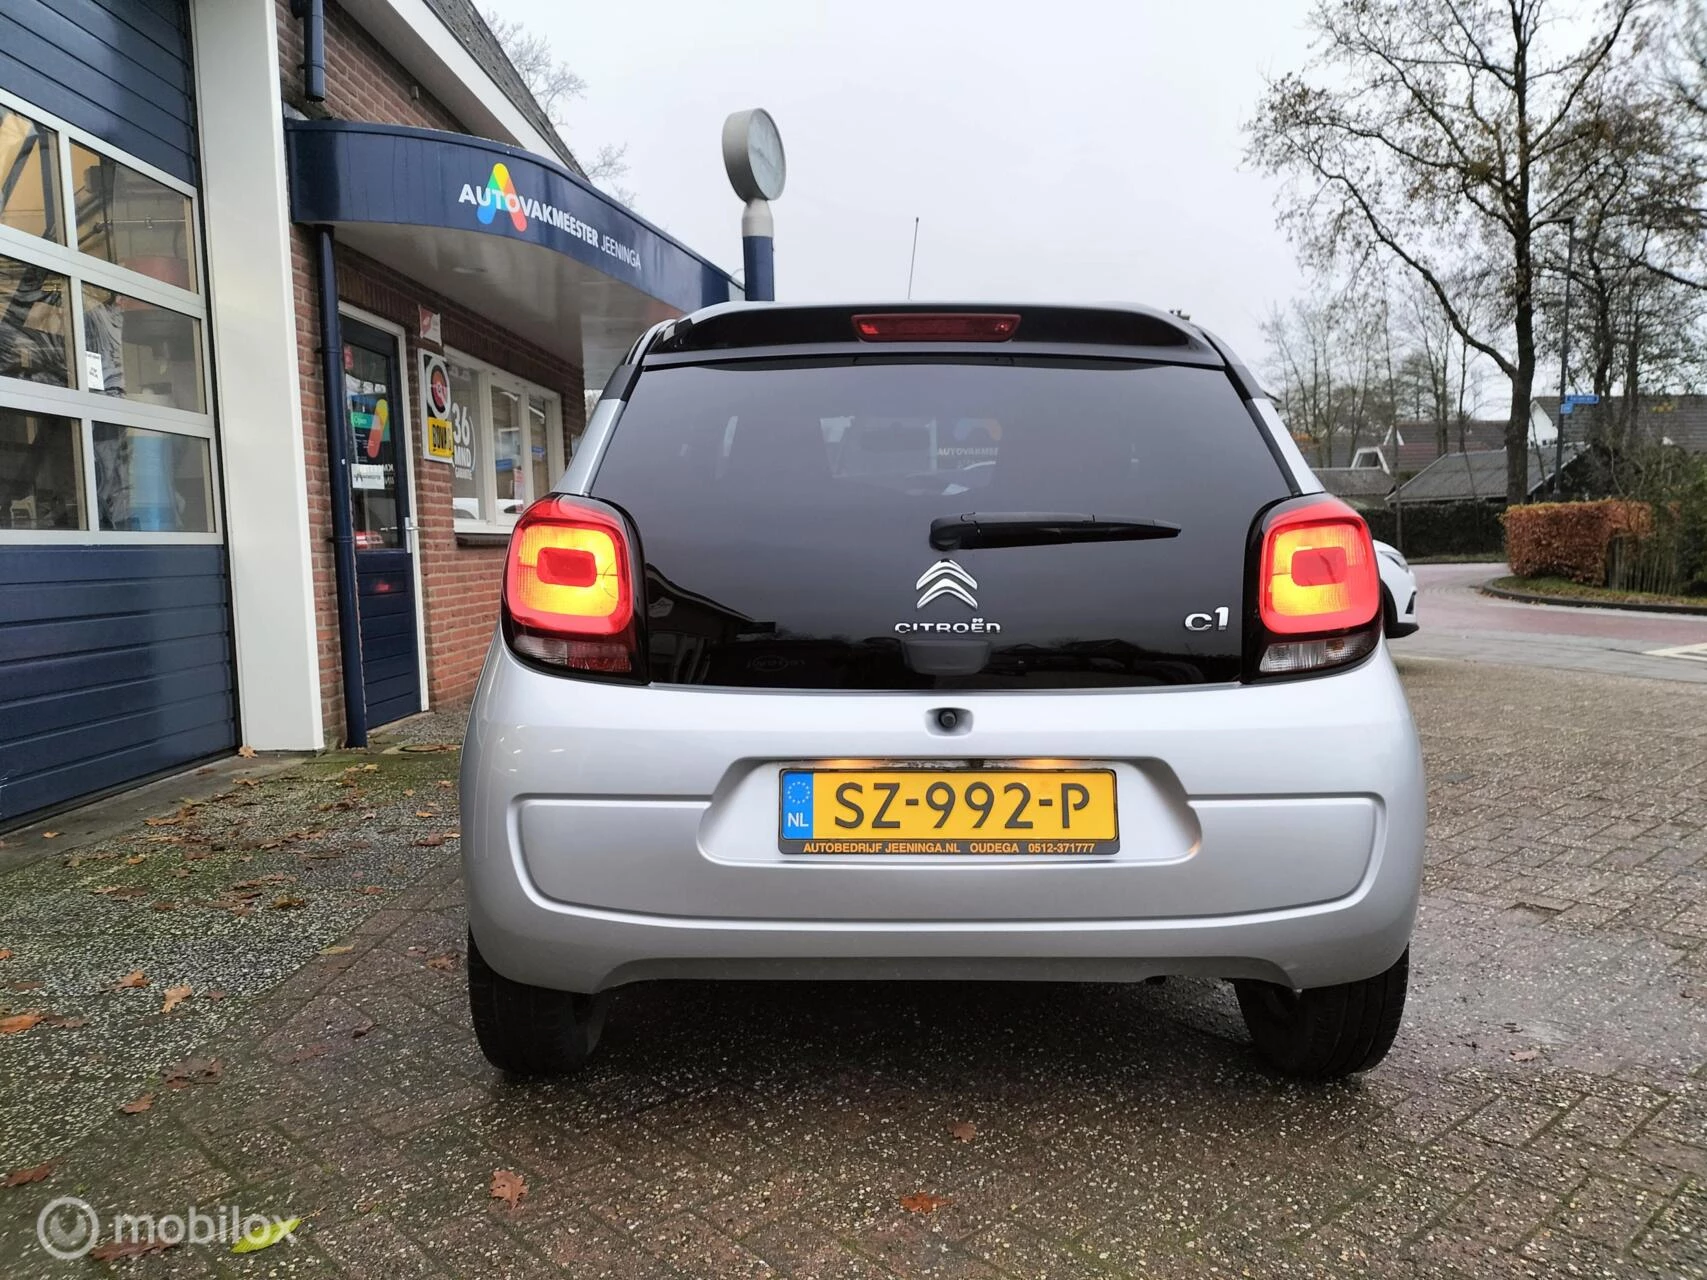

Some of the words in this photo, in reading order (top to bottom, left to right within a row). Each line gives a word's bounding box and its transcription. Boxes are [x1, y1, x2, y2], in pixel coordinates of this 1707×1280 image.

[458, 183, 599, 249] AUTOVAKMEESTER
[600, 235, 642, 272] JEENINGA
[452, 402, 471, 446] 36
[453, 445, 472, 468] MND
[894, 617, 1001, 633] CITROËN
[1184, 606, 1229, 631] C1
[834, 780, 1090, 829] SZ-992-P
[787, 812, 809, 828] NL
[803, 842, 883, 854] AUTOBEDRIJF
[885, 842, 961, 854] JEENINGA.NL
[969, 842, 1020, 854] OUDEGA
[1028, 843, 1096, 854] 0512-371777
